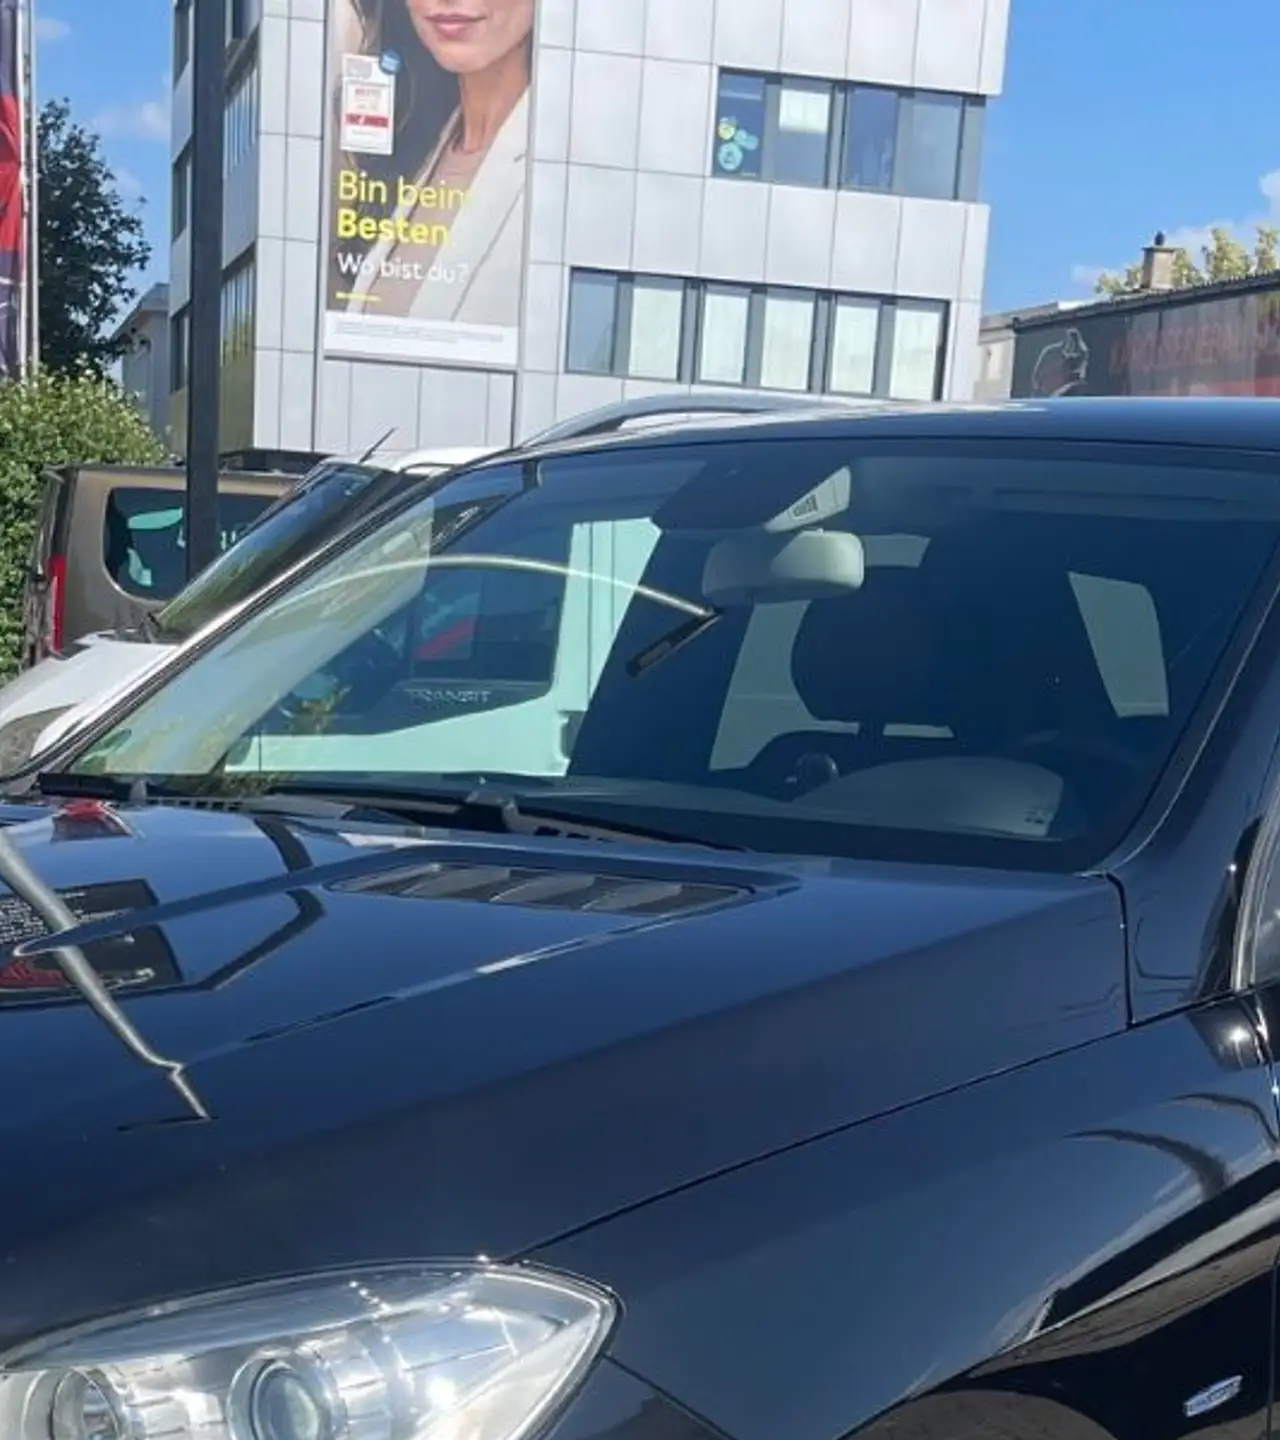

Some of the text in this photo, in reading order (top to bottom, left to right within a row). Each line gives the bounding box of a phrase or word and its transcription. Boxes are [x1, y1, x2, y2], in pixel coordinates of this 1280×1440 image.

[338, 169, 388, 205] Bin
[336, 251, 375, 275] Wo
[379, 256, 425, 281] bist
